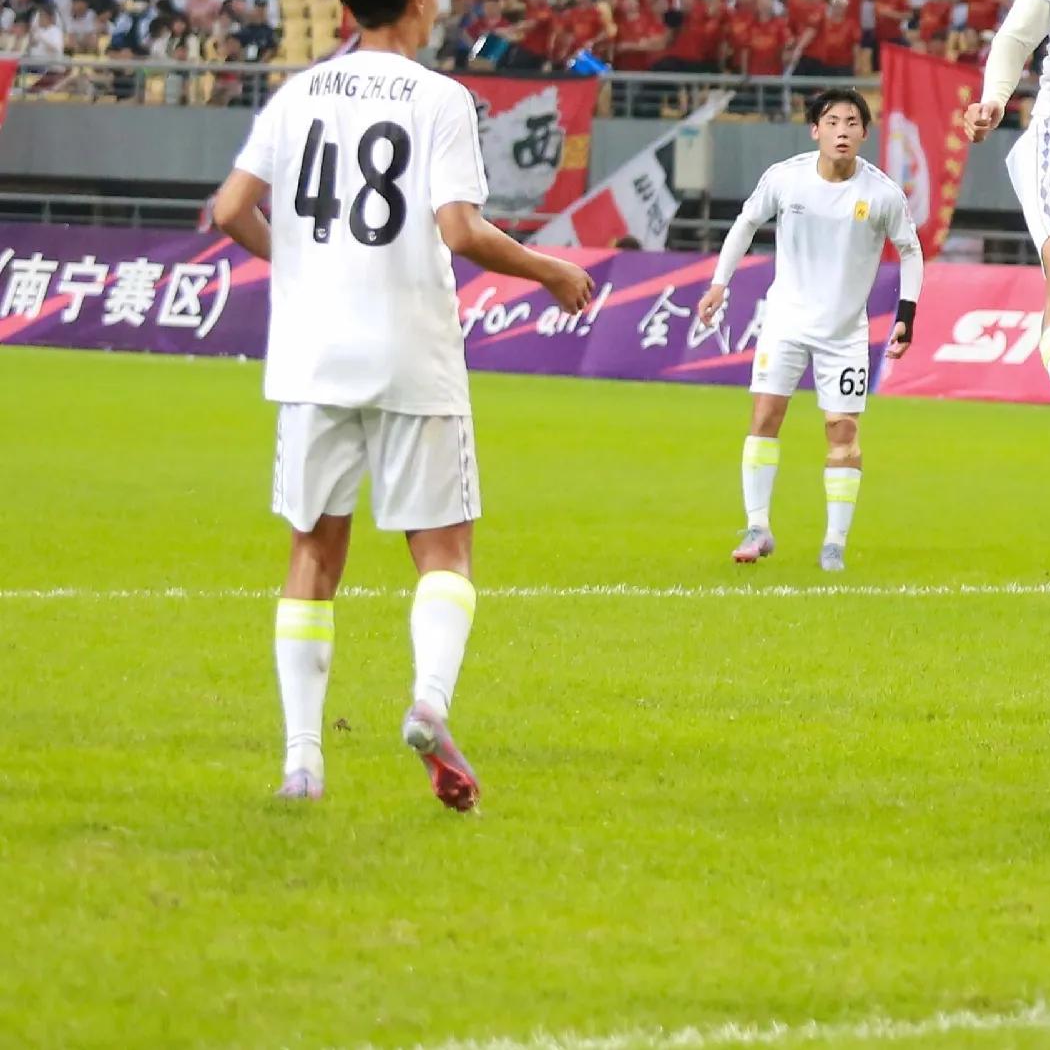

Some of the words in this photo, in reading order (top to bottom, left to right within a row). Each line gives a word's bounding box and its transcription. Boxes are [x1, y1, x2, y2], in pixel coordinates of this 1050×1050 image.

[309, 71, 360, 97] WANG
[295, 118, 411, 246] 48
[463, 286, 531, 337] for
[840, 367, 866, 396] 63
